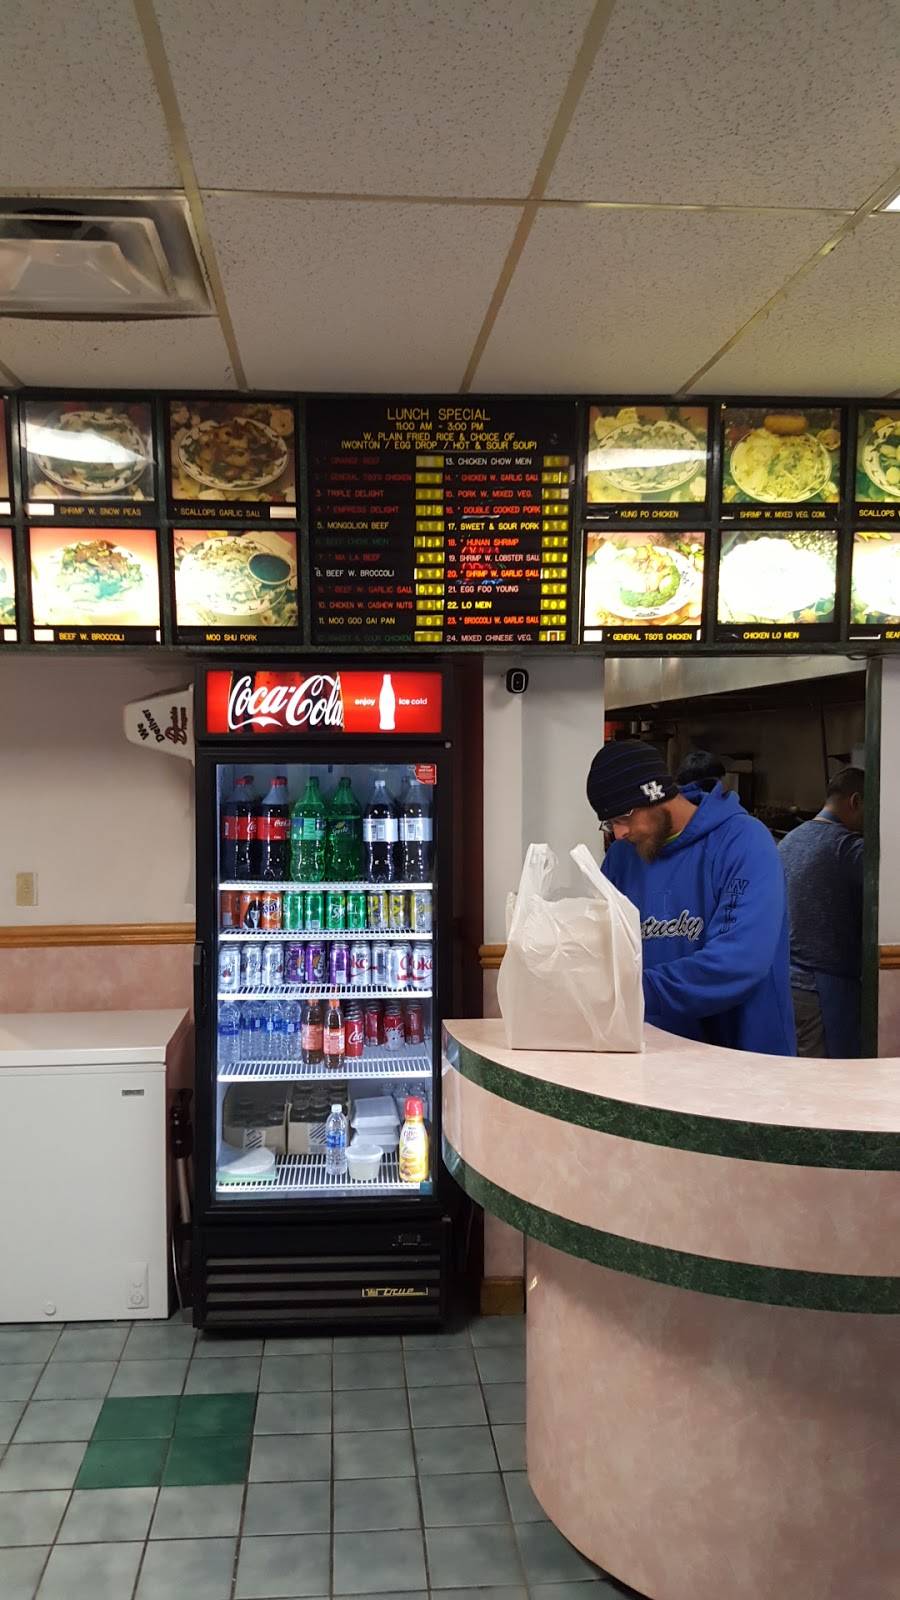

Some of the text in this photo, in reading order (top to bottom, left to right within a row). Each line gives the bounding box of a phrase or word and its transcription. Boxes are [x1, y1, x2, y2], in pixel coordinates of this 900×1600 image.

[387, 408, 490, 421] LUNCH SPECIAL
[396, 422, 415, 430] 11:00
[420, 422, 432, 430] AM
[448, 422, 467, 430] 3:00
[471, 422, 484, 430] PM
[363, 432, 515, 440] W. PLAIN FRIED RICE & CHOICE OF
[384, 441, 390, 449] /
[394, 441, 411, 449] EGG
[415, 441, 437, 449] DROP
[443, 441, 449, 449] /
[453, 441, 470, 449] HOT
[474, 441, 481, 449] &
[486, 441, 508, 449] SOUR
[445, 458, 455, 466] 13.
[457, 458, 487, 466] CHICKEN
[491, 458, 511, 466] CHOW
[515, 458, 532, 466] MEIN
[461, 473, 488, 481] CHICKEN
[490, 473, 498, 481] W.
[500, 473, 522, 481] GARLIC
[327, 489, 351, 497] TRIPLE
[354, 489, 384, 497] DELIGHT
[60, 506, 84, 515] SHRIMP
[100, 507, 120, 515] SNOW
[122, 508, 141, 516] PEAS
[181, 507, 216, 516] SCALLOPS
[219, 509, 242, 517] GARLIC
[463, 506, 490, 514] DOUBLE
[493, 506, 520, 514] COOKED
[522, 506, 540, 514] PORK
[621, 510, 679, 518] KUNG PO CHICKEN
[740, 511, 761, 519] SHRIMP
[764, 511, 772, 519] W.
[775, 511, 793, 519] MIXED
[371, 521, 389, 529] BEEF
[466, 538, 490, 546] HUNAN
[494, 538, 519, 546] SHRIMP
[447, 570, 458, 578] 20.
[466, 570, 488, 578] SHRIMP
[490, 570, 499, 578] W.
[501, 570, 522, 578] GARLIC
[448, 585, 457, 593] 21.
[460, 585, 474, 593] EGG
[477, 585, 492, 593] FOO
[496, 585, 519, 593] YOUNG
[329, 601, 354, 609] CHICKEN
[368, 601, 393, 609] CASHEW
[396, 601, 414, 609] NUTS
[447, 601, 458, 609] 22.
[462, 601, 472, 609] LO
[475, 601, 492, 609] MEIN
[329, 616, 344, 624] MOO
[348, 616, 362, 624] GOO
[366, 616, 377, 624] GAI
[381, 616, 396, 624] PAN
[59, 632, 125, 641] BEEF W. BROCCOLI
[613, 633, 692, 641] GENERAL TSO'S CHICKEN
[227, 674, 345, 730] Coca-Cola
[354, 698, 376, 706] enjoy
[142, 709, 165, 742] Deliver
[137, 723, 149, 740] We
[640, 780, 666, 801] UK
